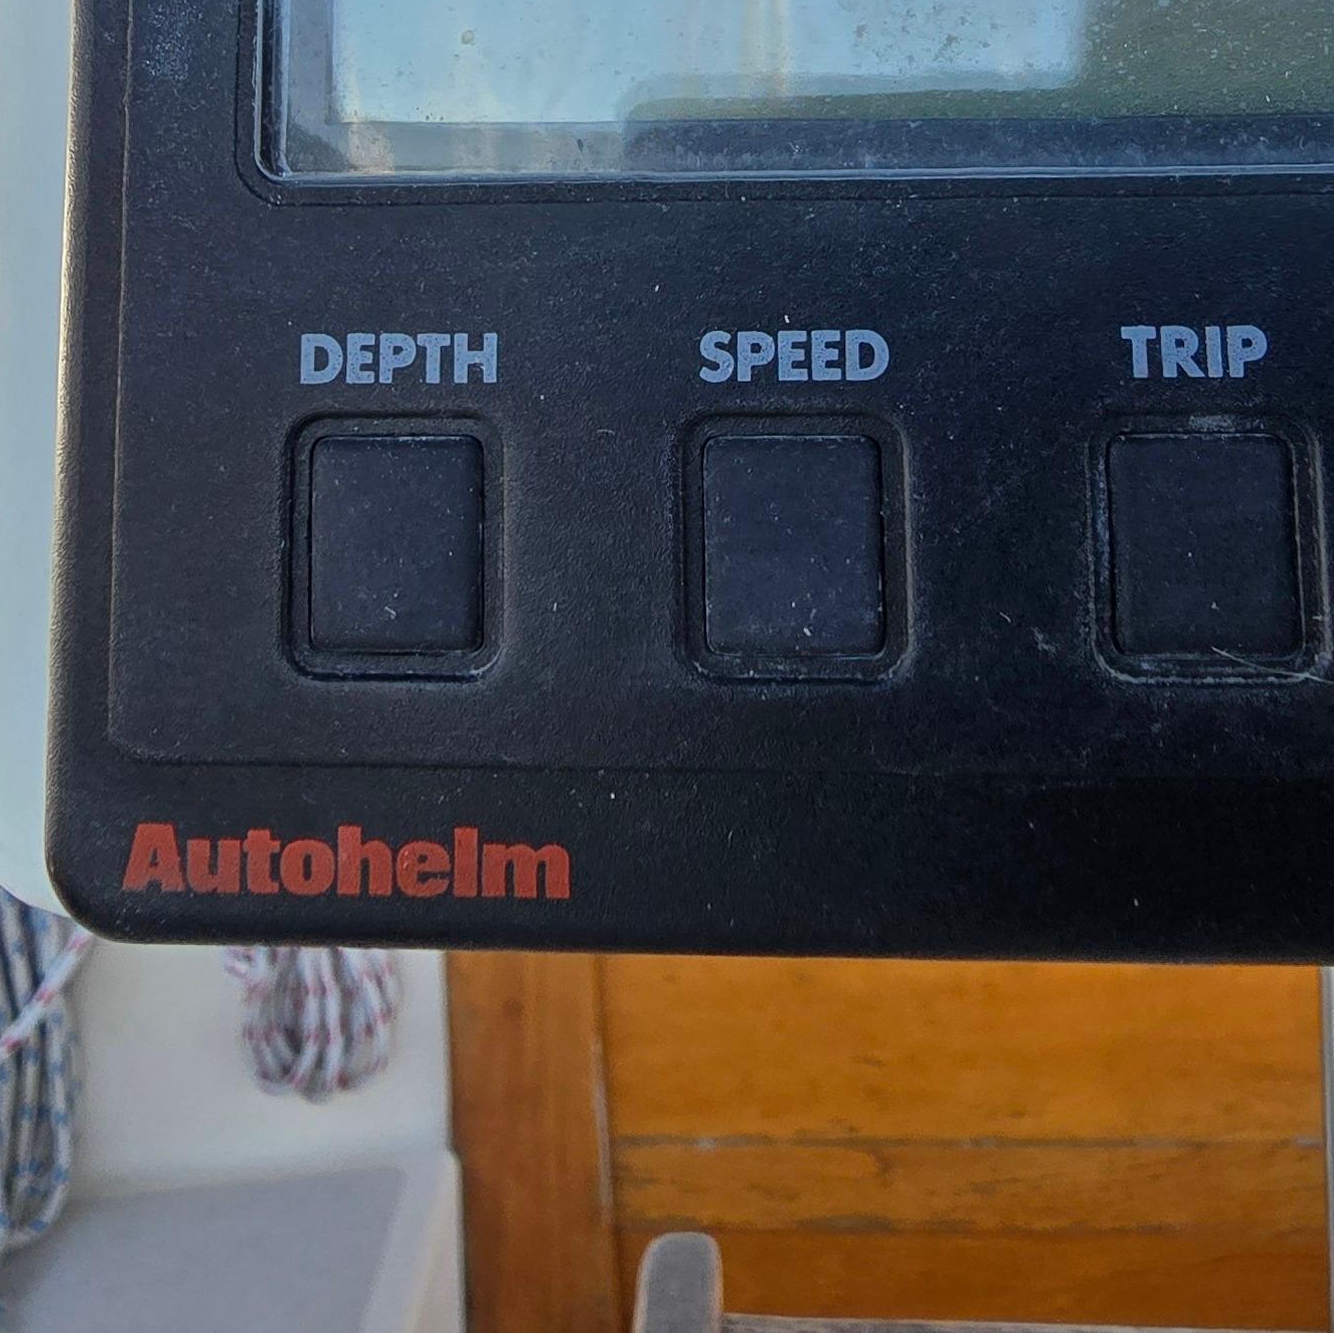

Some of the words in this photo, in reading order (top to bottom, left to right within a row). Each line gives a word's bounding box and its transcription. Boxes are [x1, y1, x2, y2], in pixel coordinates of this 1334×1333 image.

[300, 333, 498, 385] DEPTH
[699, 329, 890, 383] SPEED
[1121, 325, 1267, 378] TRIP
[123, 823, 571, 899] Autohelm
